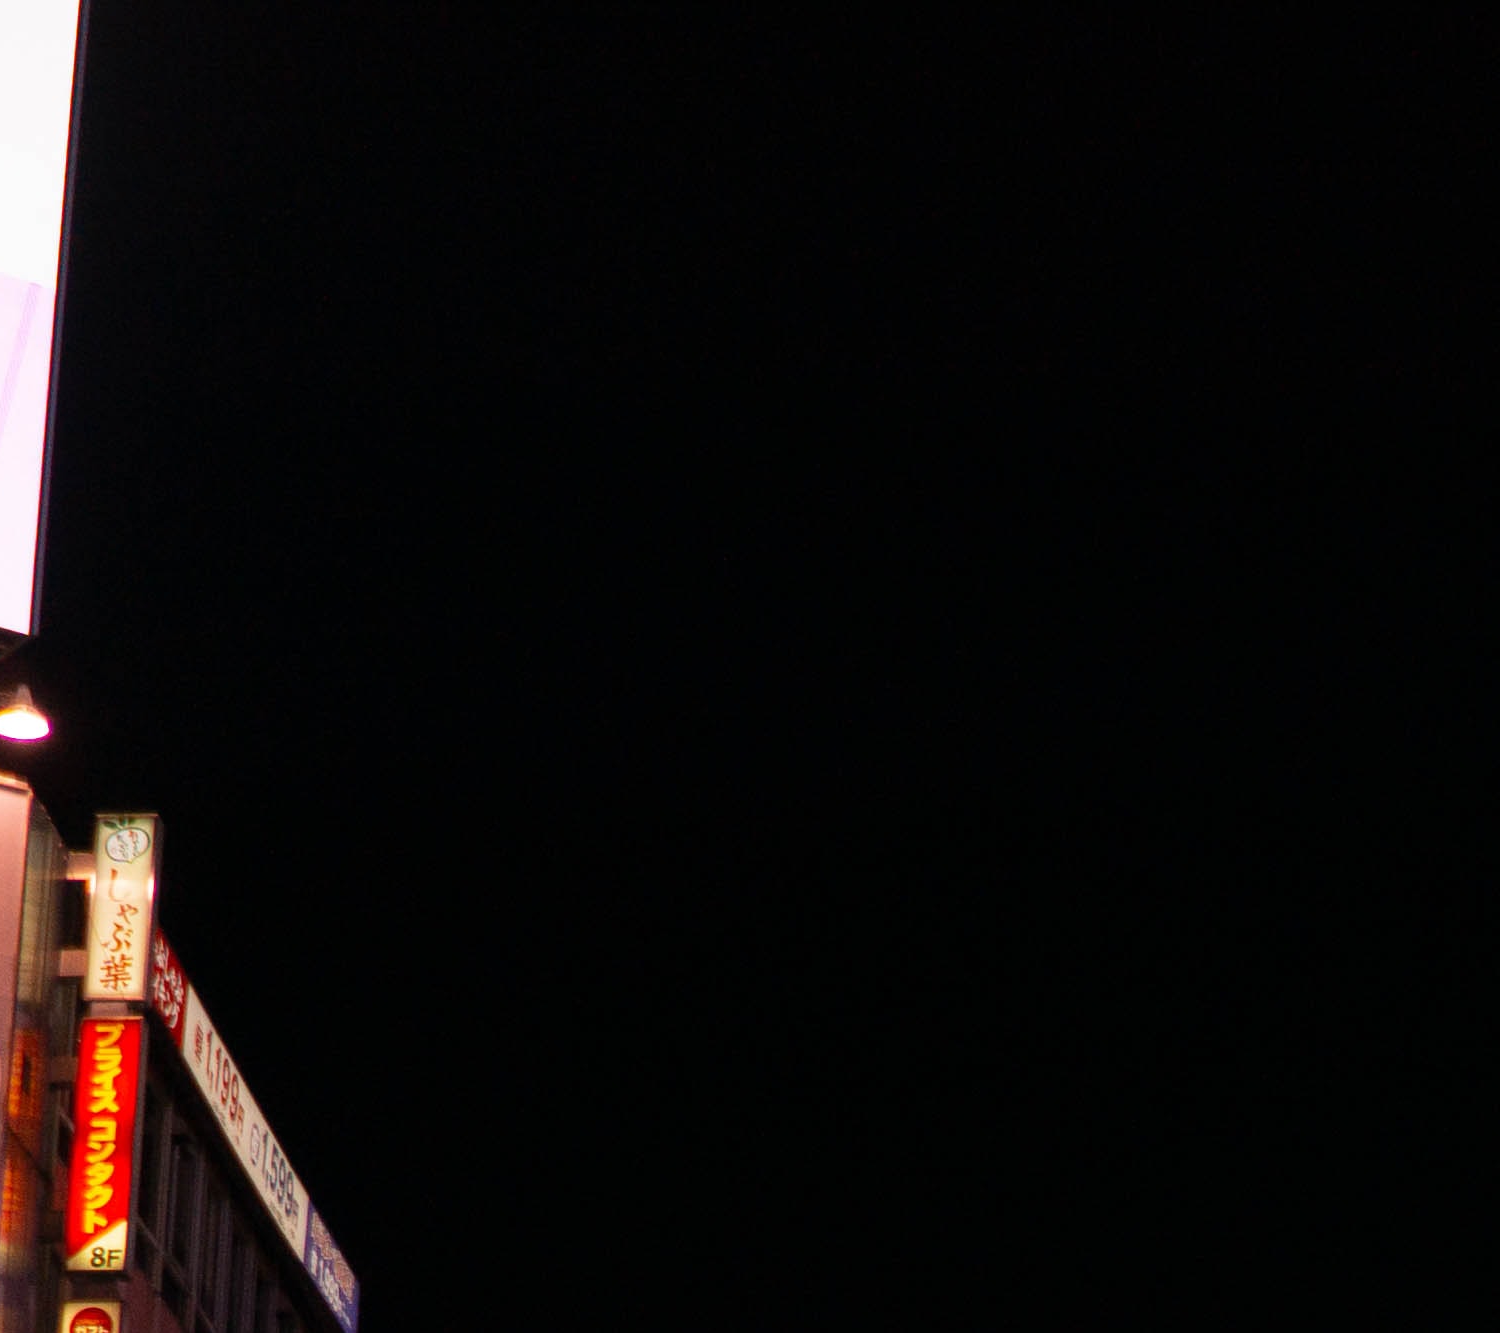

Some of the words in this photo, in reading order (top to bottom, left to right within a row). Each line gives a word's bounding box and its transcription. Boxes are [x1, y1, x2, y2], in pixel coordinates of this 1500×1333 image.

[100, 869, 140, 991] しゃぶ葉
[91, 1247, 124, 1268] 8F
